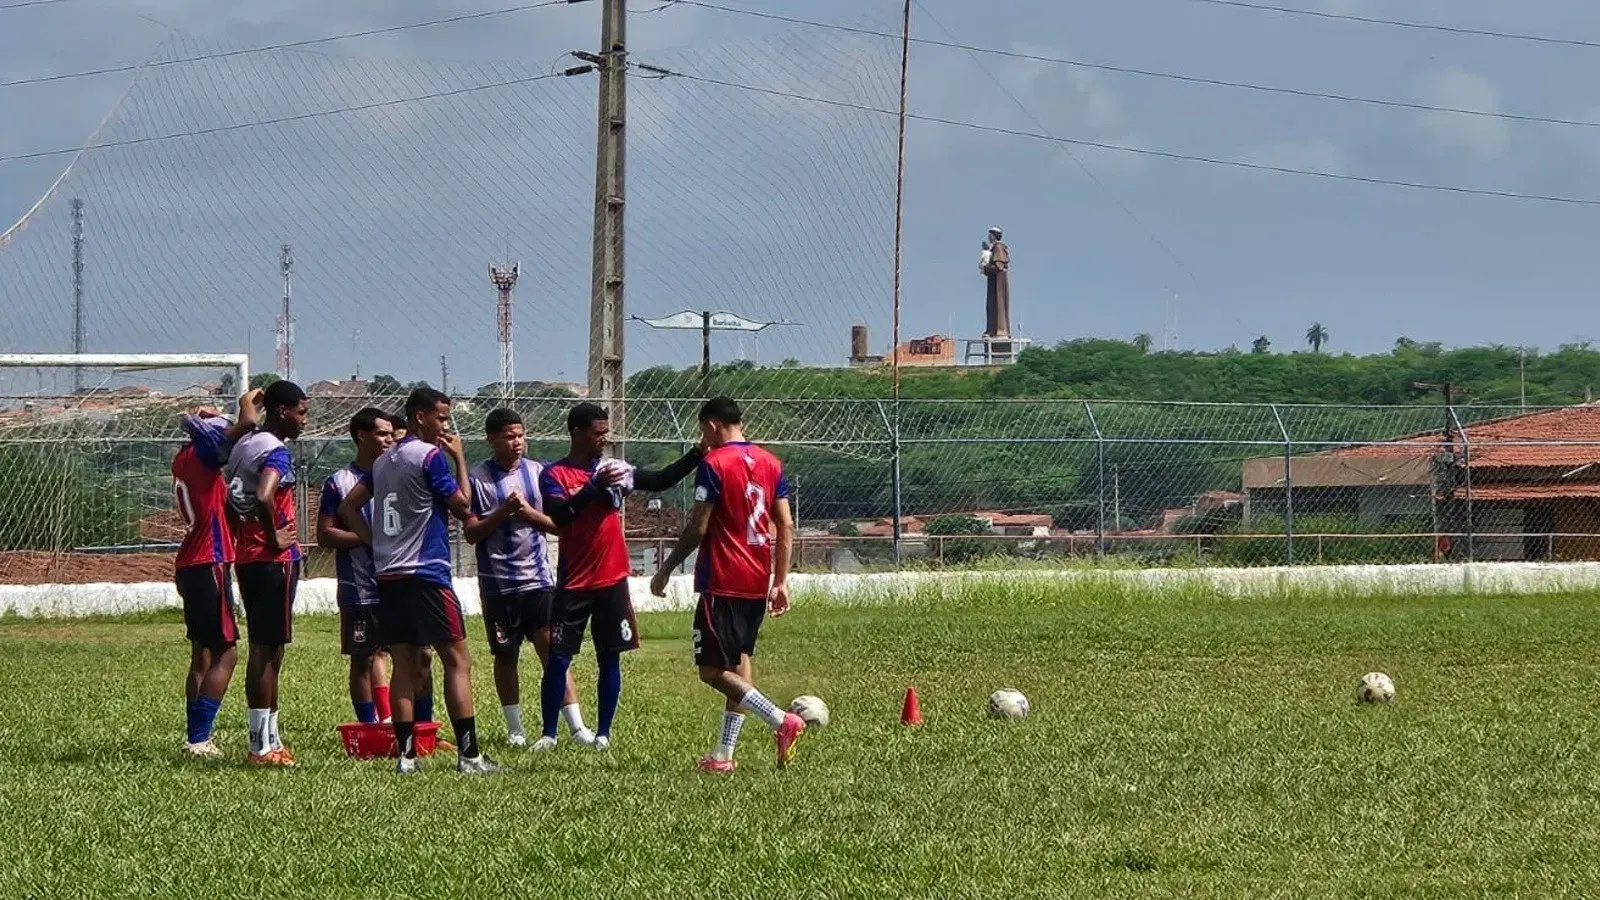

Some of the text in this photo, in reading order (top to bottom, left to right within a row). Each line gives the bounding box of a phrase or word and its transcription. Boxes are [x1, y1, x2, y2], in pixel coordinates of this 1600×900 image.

[383, 491, 403, 537] 6
[744, 481, 770, 547] 2
[620, 618, 632, 642] 8
[692, 628, 702, 654] 2
